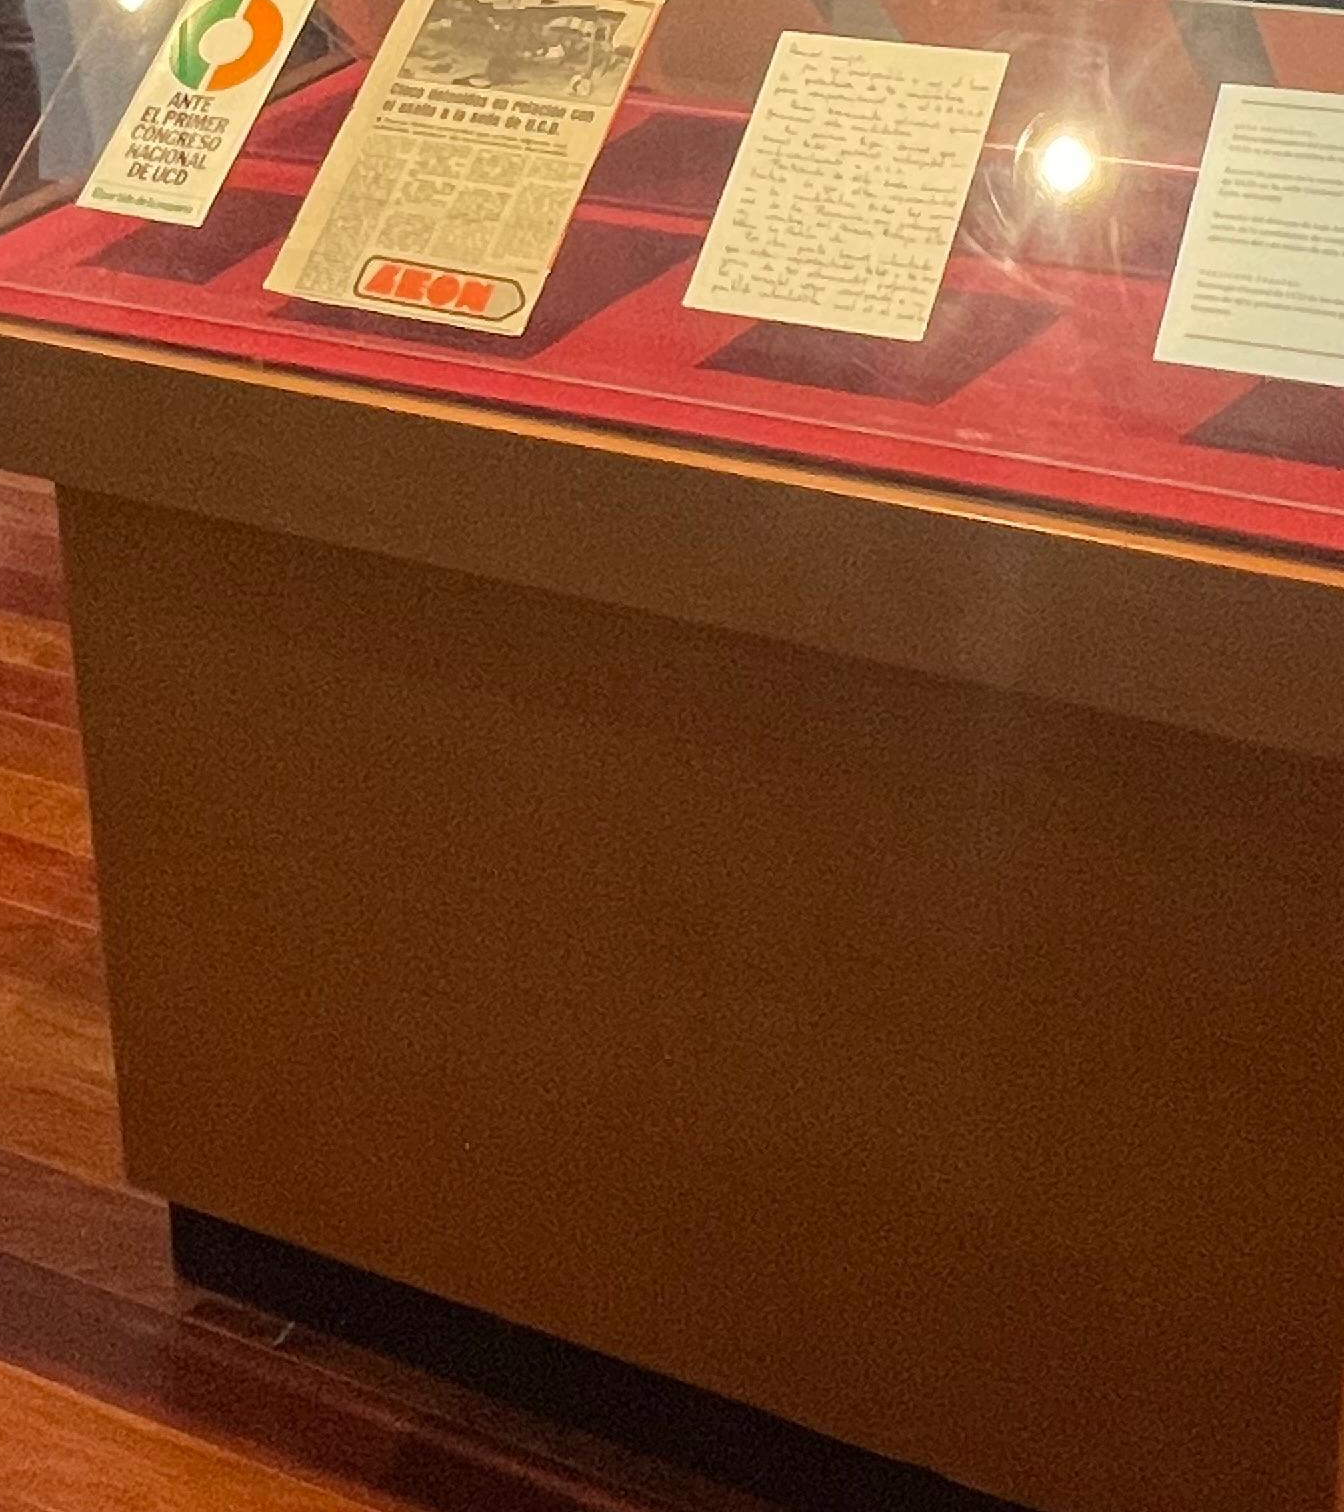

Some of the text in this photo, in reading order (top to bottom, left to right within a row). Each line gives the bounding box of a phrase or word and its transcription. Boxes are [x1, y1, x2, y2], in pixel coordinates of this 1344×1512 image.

[167, 91, 216, 113] ANTE
[141, 105, 230, 134] EL PRIMER
[131, 124, 222, 151] CONGRESO
[125, 143, 207, 170] NACIONAL
[127, 161, 188, 185] DE UCD
